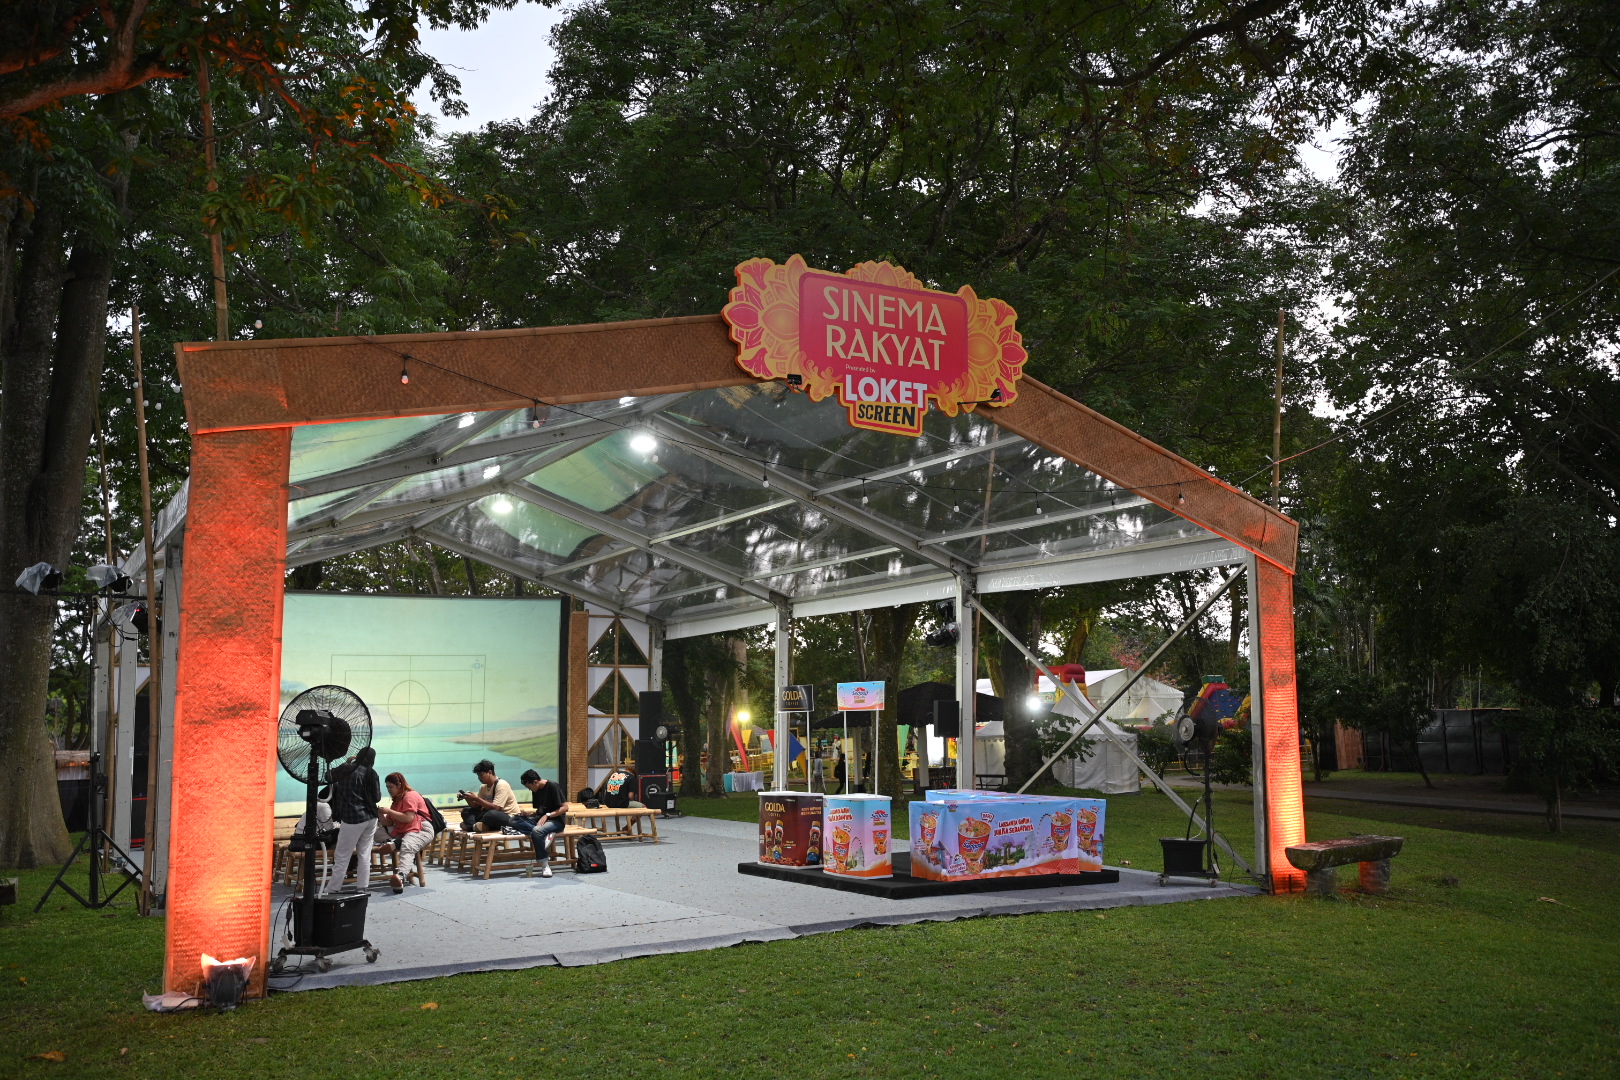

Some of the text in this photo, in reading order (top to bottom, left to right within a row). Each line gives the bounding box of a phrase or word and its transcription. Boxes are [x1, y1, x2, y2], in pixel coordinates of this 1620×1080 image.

[823, 286, 947, 336] SINEMA
[826, 324, 945, 371] RAKYAT
[845, 364, 869, 373] Presented
[846, 374, 928, 408] LOKET
[858, 404, 916, 427] SCREEN
[782, 691, 803, 701] GOLDA
[764, 802, 786, 813] GOLDA
